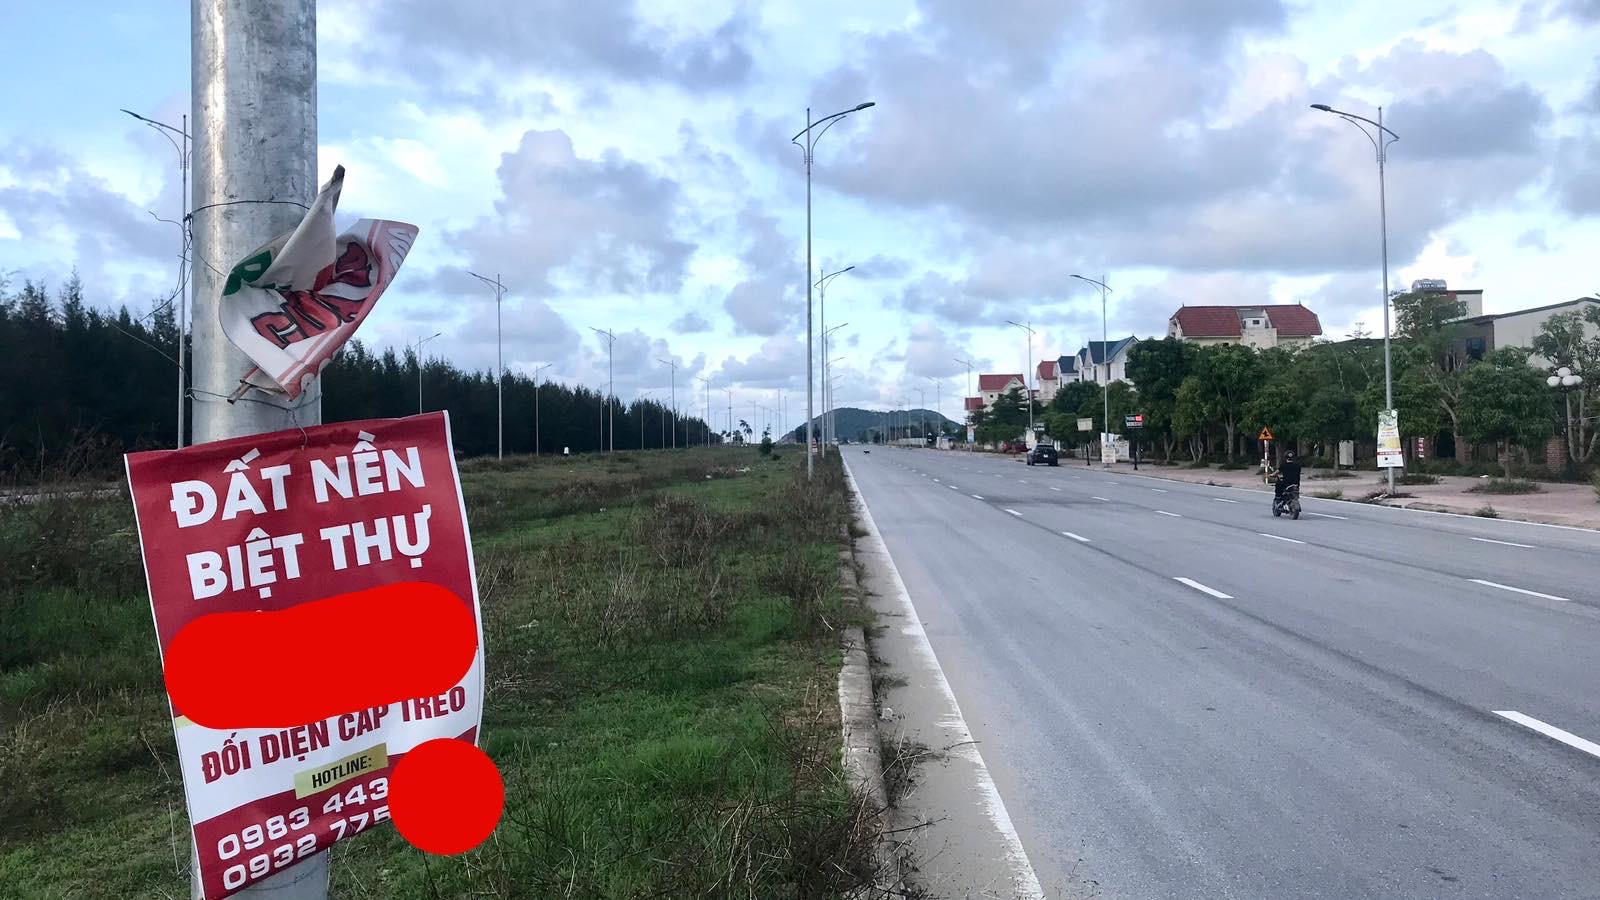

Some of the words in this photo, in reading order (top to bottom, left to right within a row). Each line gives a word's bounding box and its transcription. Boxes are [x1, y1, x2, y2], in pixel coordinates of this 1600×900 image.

[169, 447, 292, 529] ĐẤT
[309, 429, 426, 504] NỀN
[185, 526, 305, 600] BIỆT
[319, 504, 432, 571] THỰ
[201, 732, 252, 785] ĐỐI
[311, 755, 373, 789] HOTLINE:
[217, 806, 310, 861] 0983
[322, 777, 389, 815] 443
[223, 833, 318, 891] 0932
